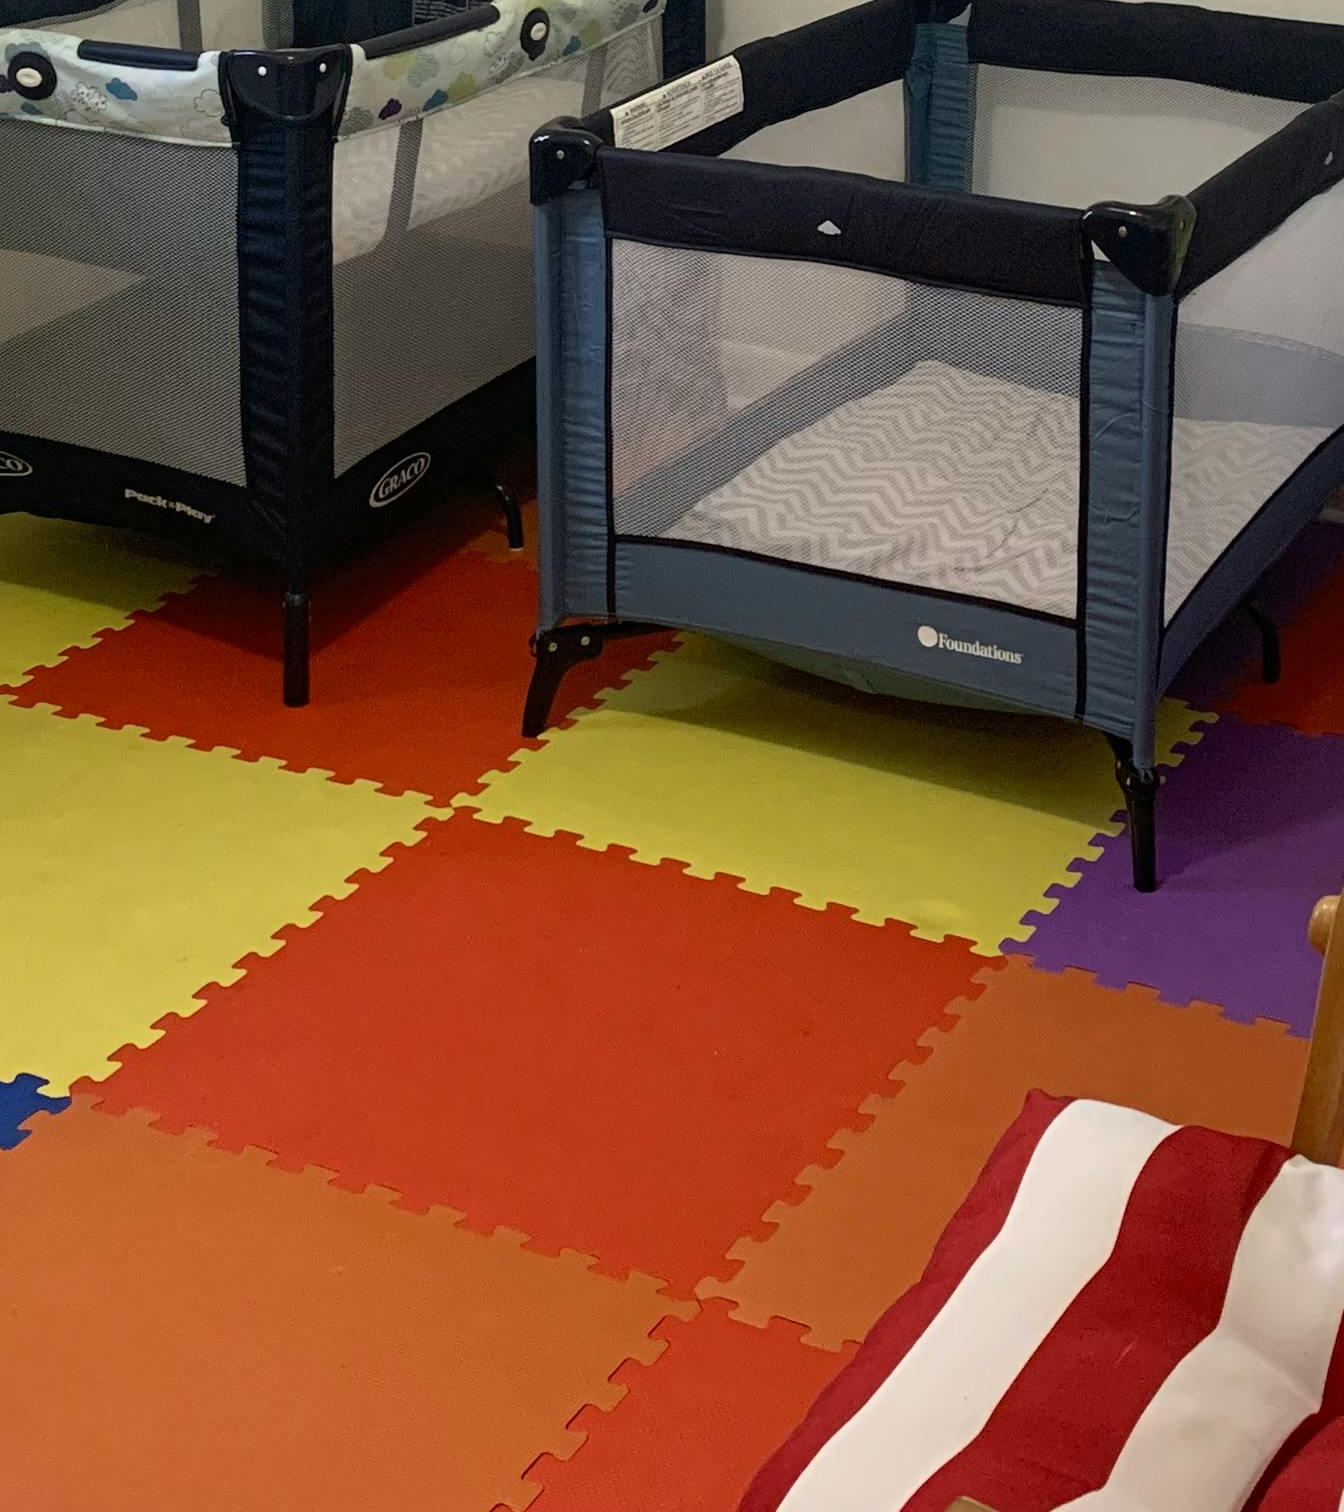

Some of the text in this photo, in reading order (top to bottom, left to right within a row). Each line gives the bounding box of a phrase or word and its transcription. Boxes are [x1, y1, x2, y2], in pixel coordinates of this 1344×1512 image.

[379, 457, 425, 499] GRACO
[124, 488, 167, 509] Pack
[175, 500, 213, 524] Play
[938, 632, 1022, 664] Foundations
